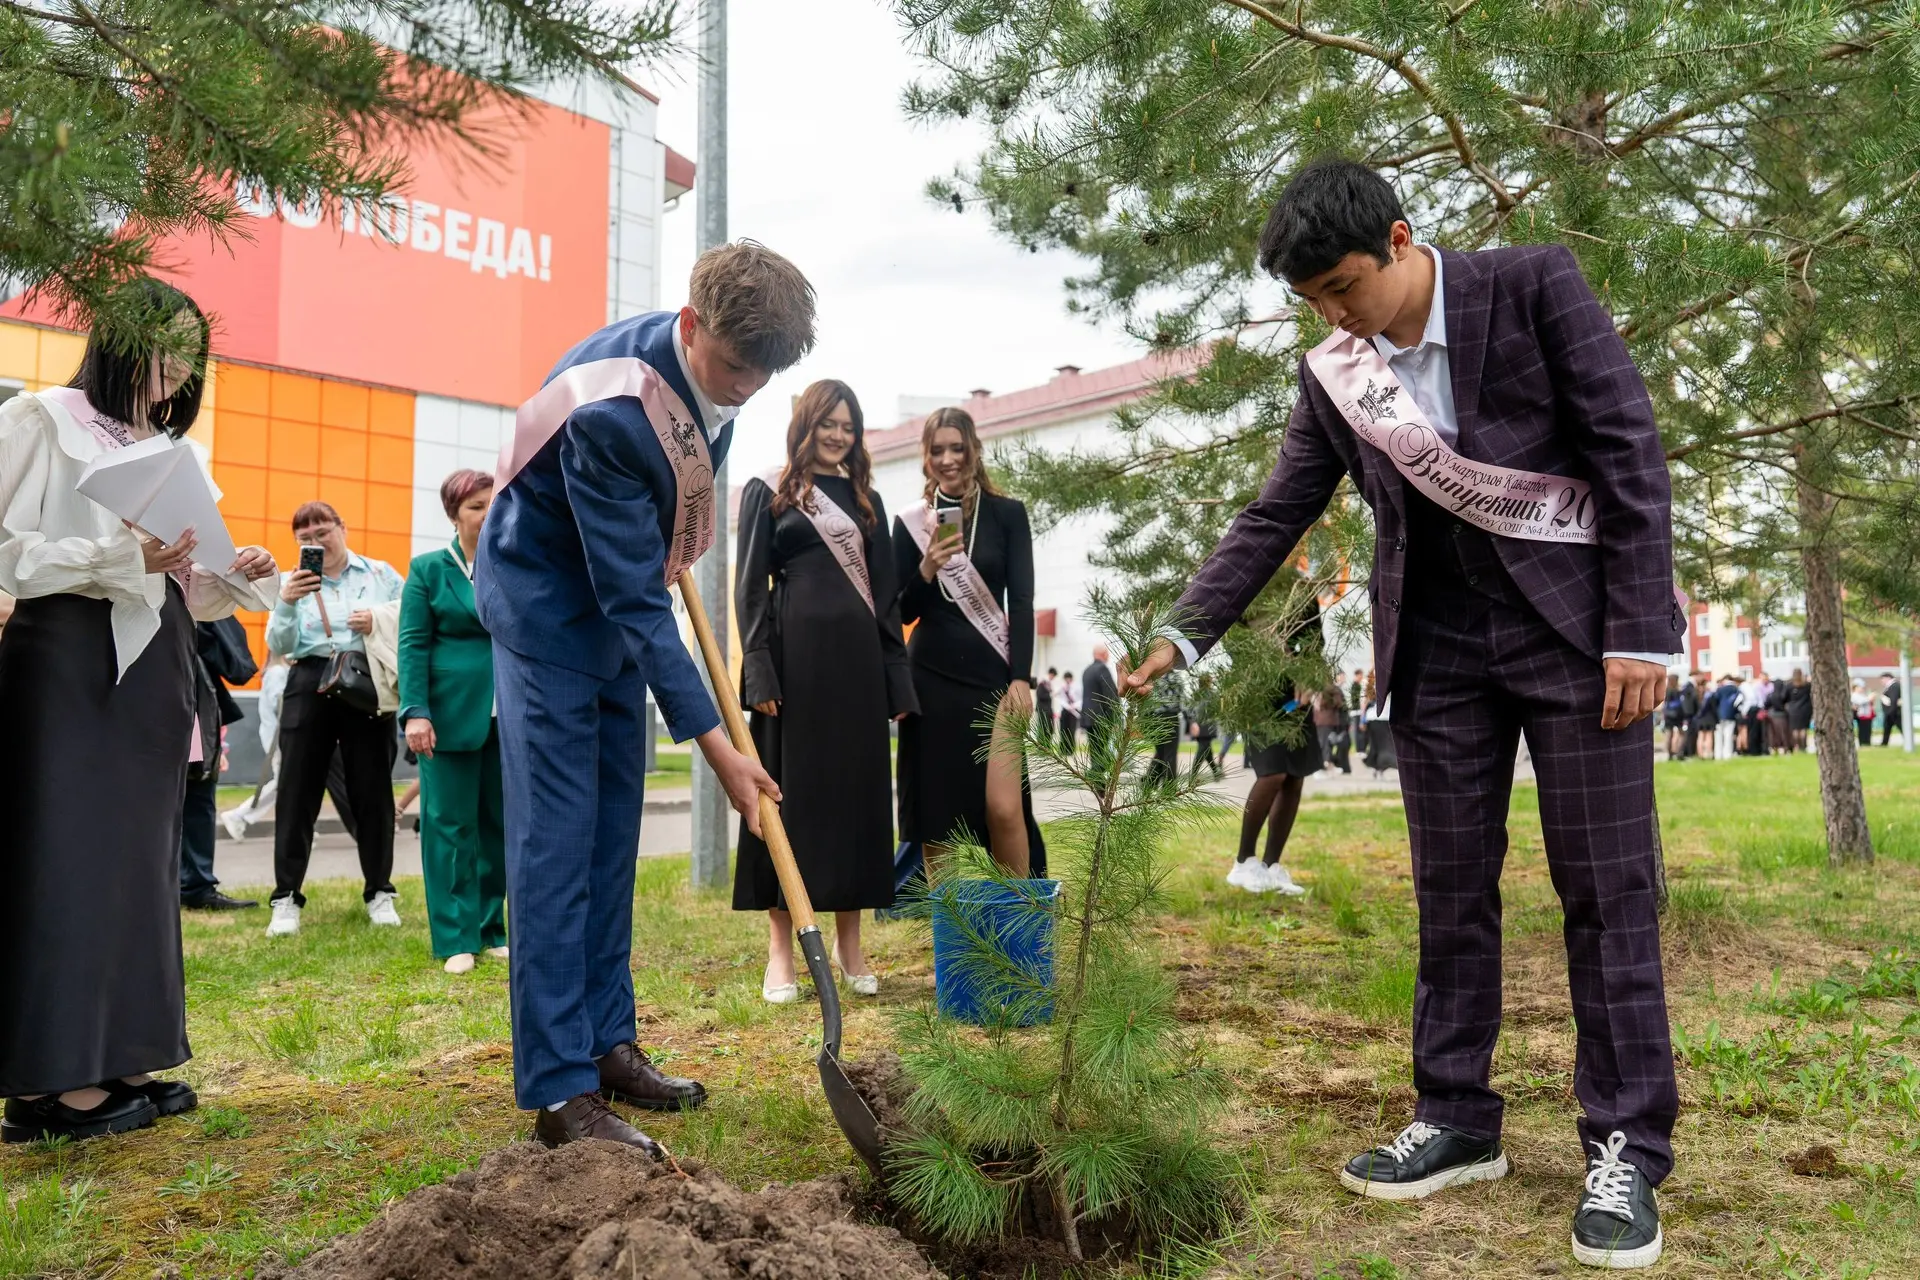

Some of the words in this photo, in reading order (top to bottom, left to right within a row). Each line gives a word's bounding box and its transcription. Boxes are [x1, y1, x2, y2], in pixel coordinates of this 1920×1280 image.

[340, 187, 552, 282] ПОБЕДА!
[660, 431, 670, 442] 11
[1389, 422, 1547, 522] Выпускник
[1440, 453, 1503, 487] Умаркулов
[675, 464, 713, 565] Выпускник
[1463, 509, 1500, 527] МБОУ
[1498, 521, 1525, 534] СОШ
